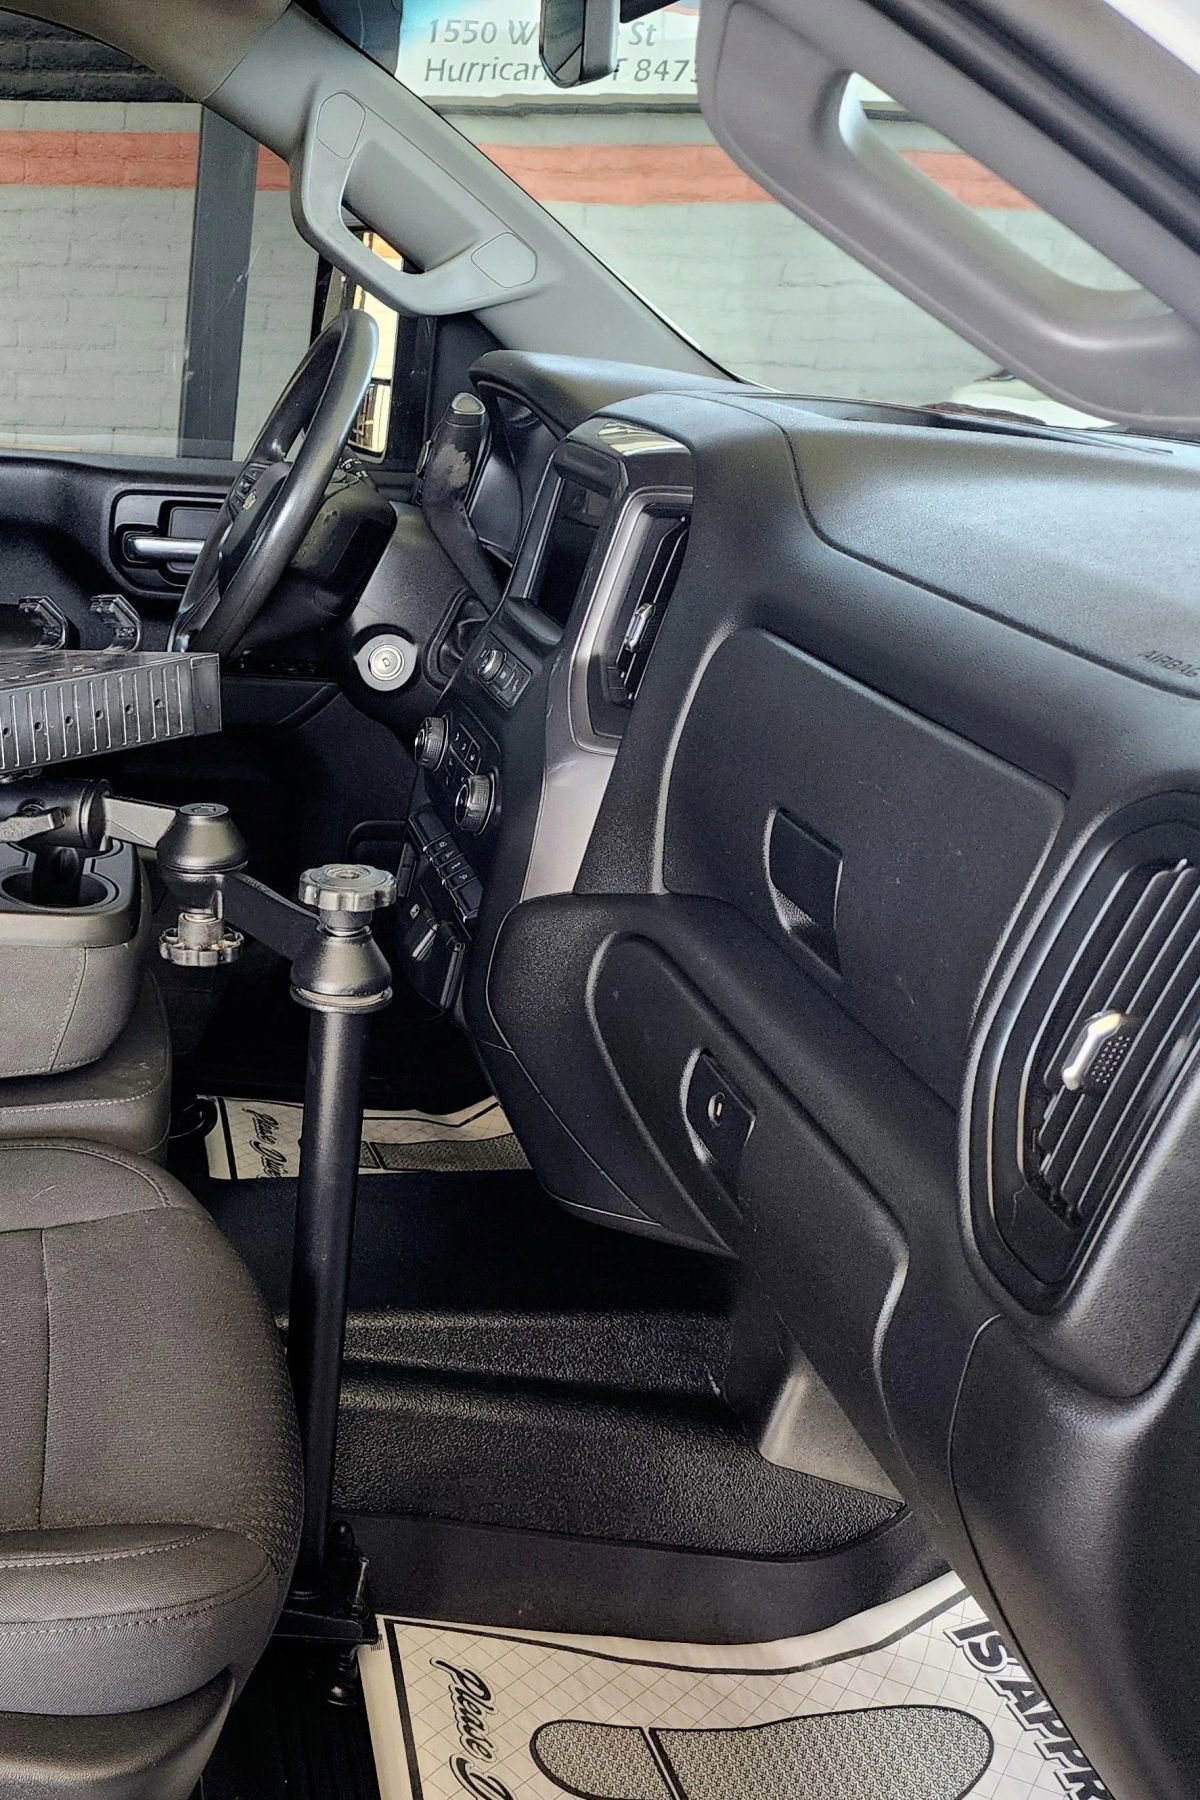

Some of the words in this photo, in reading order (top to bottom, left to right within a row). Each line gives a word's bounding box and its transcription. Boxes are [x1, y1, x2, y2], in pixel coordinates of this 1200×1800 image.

[429, 18, 498, 44] 1550
[508, 19, 539, 46] W
[628, 21, 657, 46] St
[633, 58, 698, 83] 847
[1136, 650, 1200, 678] AIRBAG
[430, 1657, 498, 1763] Please
